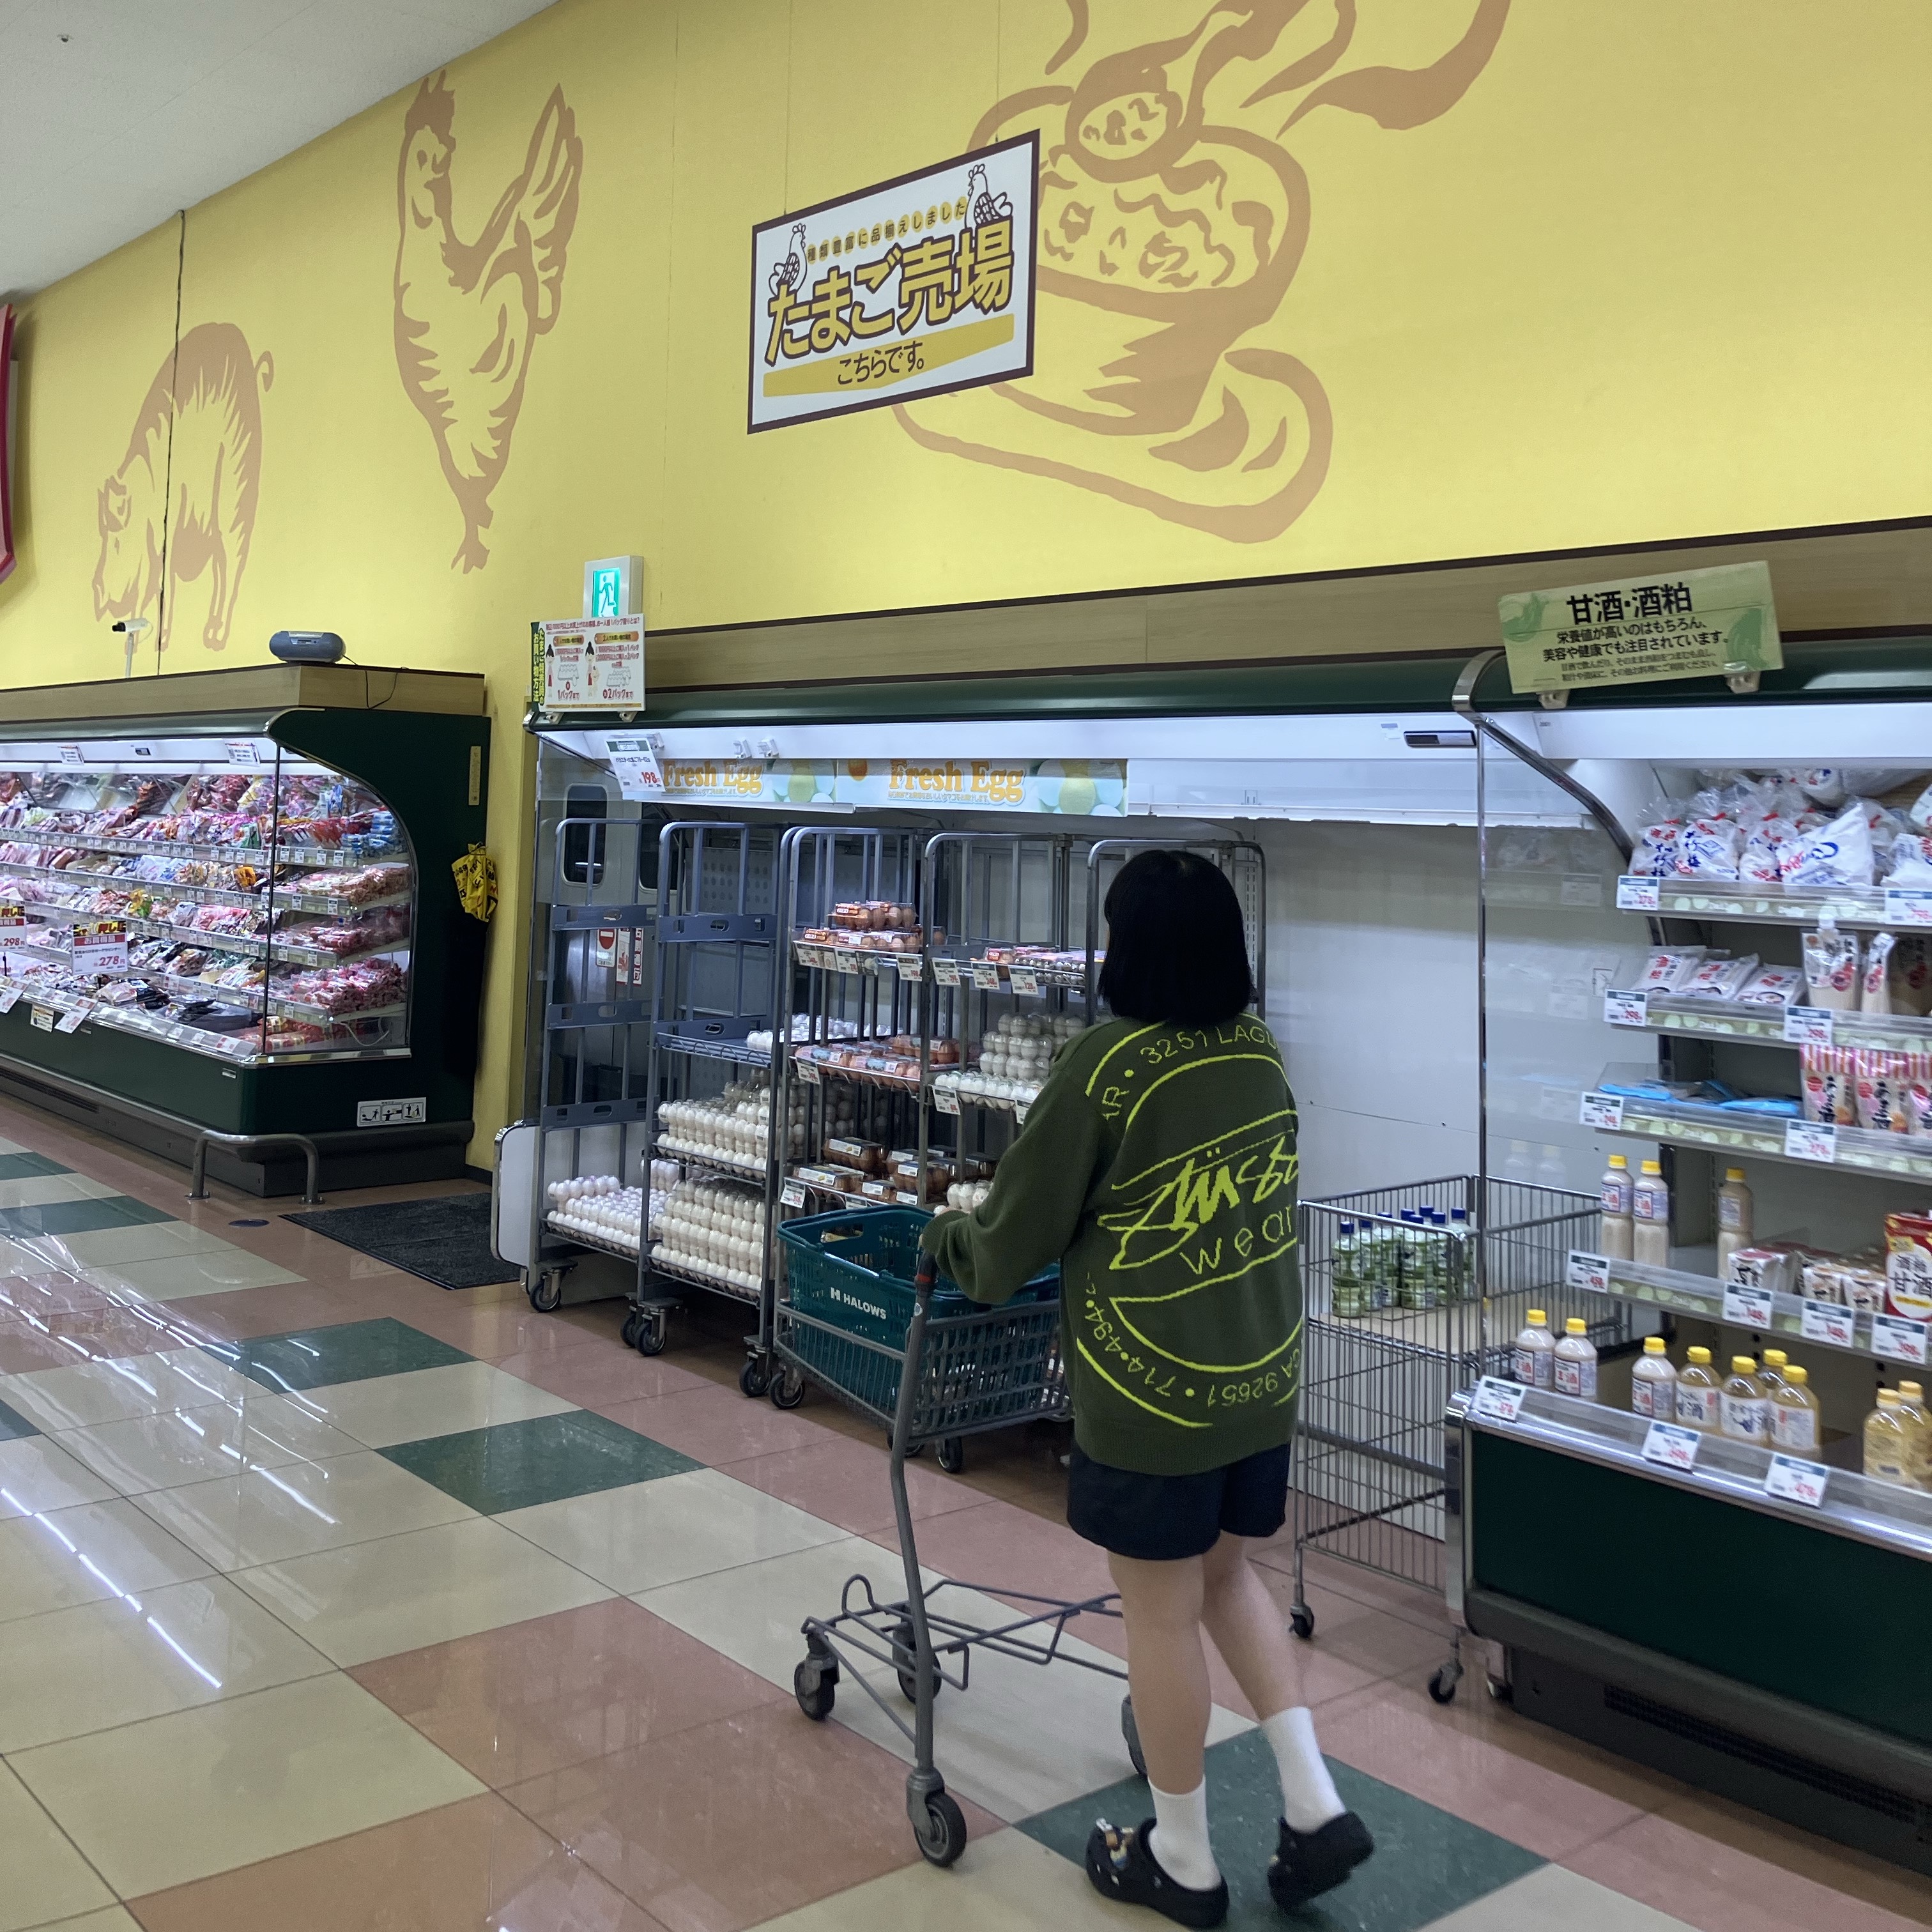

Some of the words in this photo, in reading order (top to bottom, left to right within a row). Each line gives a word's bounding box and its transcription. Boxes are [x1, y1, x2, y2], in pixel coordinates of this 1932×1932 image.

[807, 201, 966, 263] 種類豊富に品揃えしました
[765, 215, 1015, 367] たまご売場
[838, 341, 924, 385] こちらです。
[1567, 582, 1692, 625] 甘酒・酒粕
[663, 760, 717, 787] Fresh
[723, 759, 763, 794] Egg
[889, 758, 963, 792] Fresh
[970, 760, 1024, 803] Egg
[1139, 1029, 1208, 1064] 3251
[1179, 1204, 1292, 1275] wear
[843, 1292, 887, 1320] HALOWS
